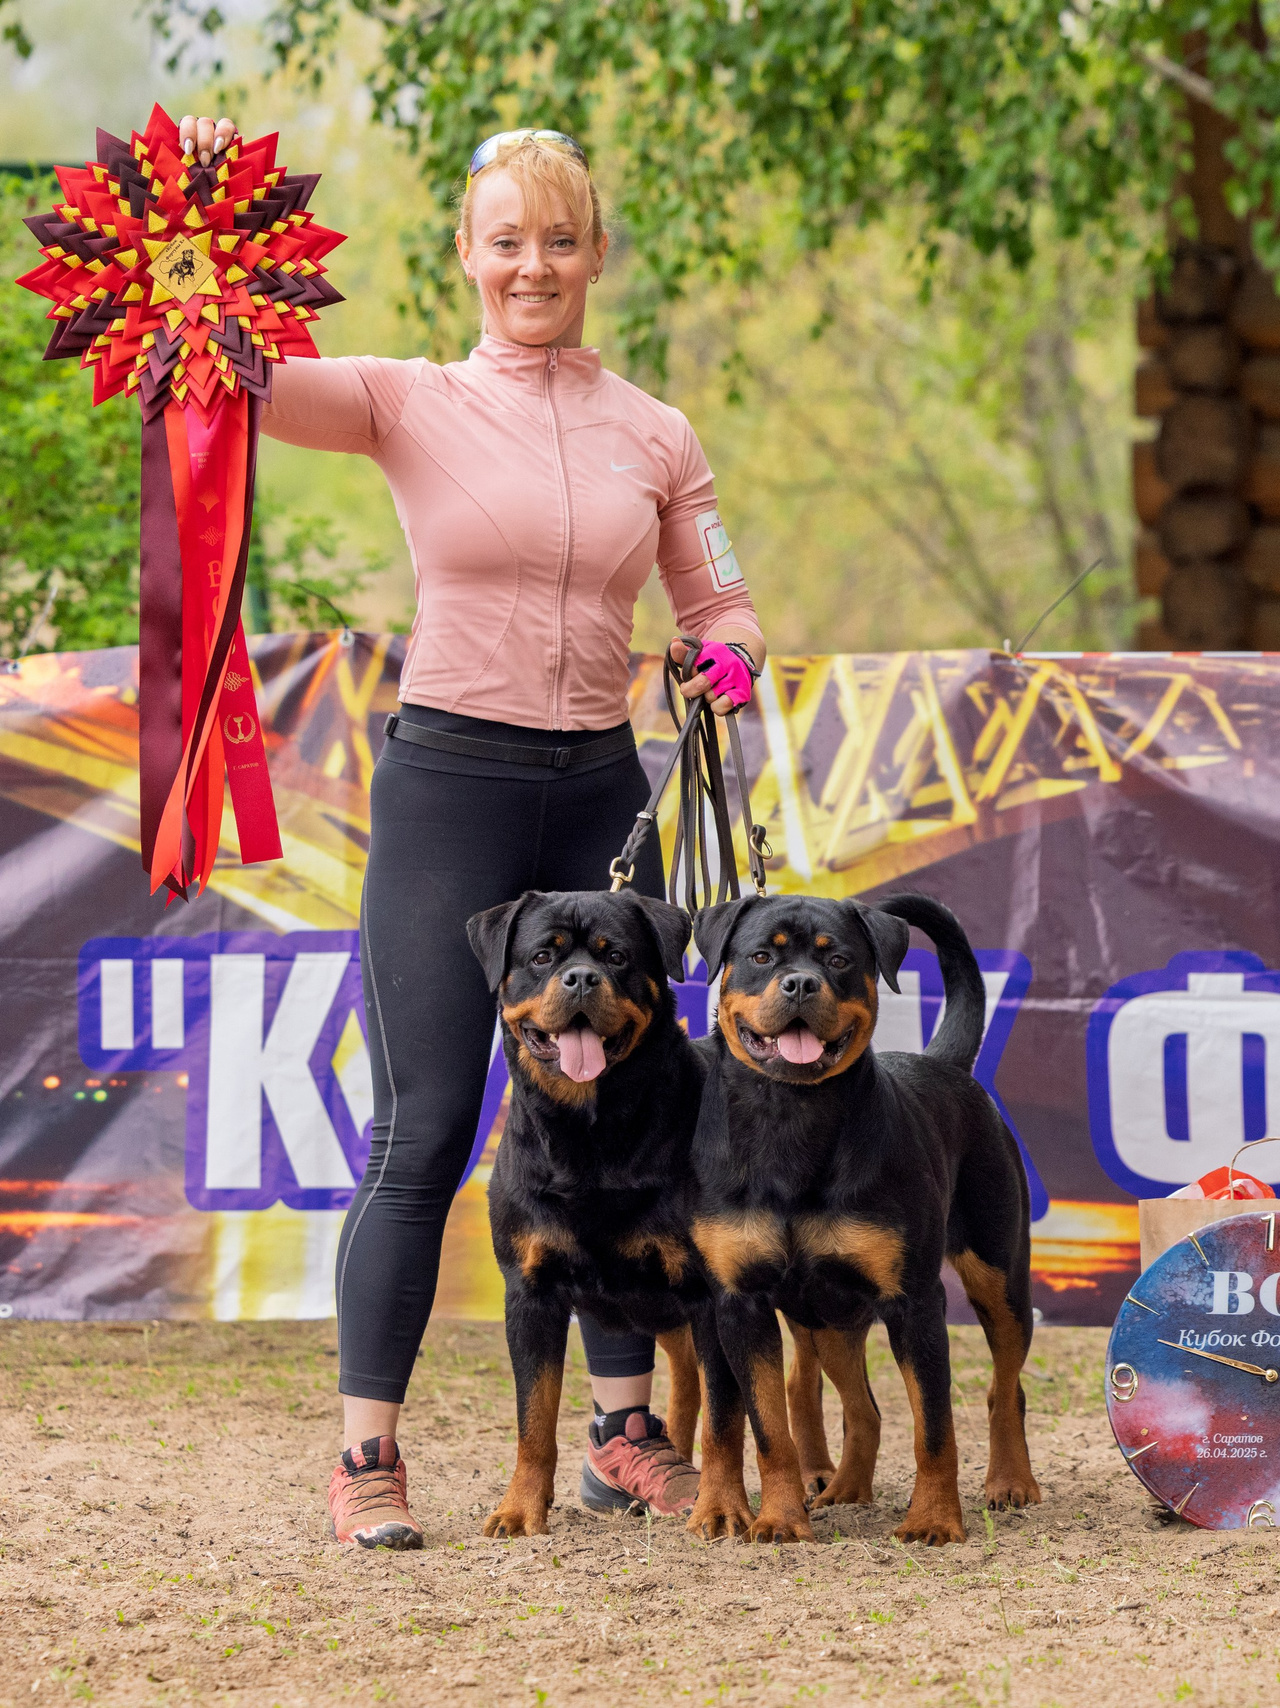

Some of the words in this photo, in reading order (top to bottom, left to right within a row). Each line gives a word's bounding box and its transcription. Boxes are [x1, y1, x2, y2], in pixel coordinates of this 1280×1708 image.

[1178, 1329, 1247, 1353] Кубок
[1110, 1363, 1139, 1402] 9
[1213, 1432, 1264, 1445] Саратов
[1196, 1447, 1258, 1459] 26.04.2025
